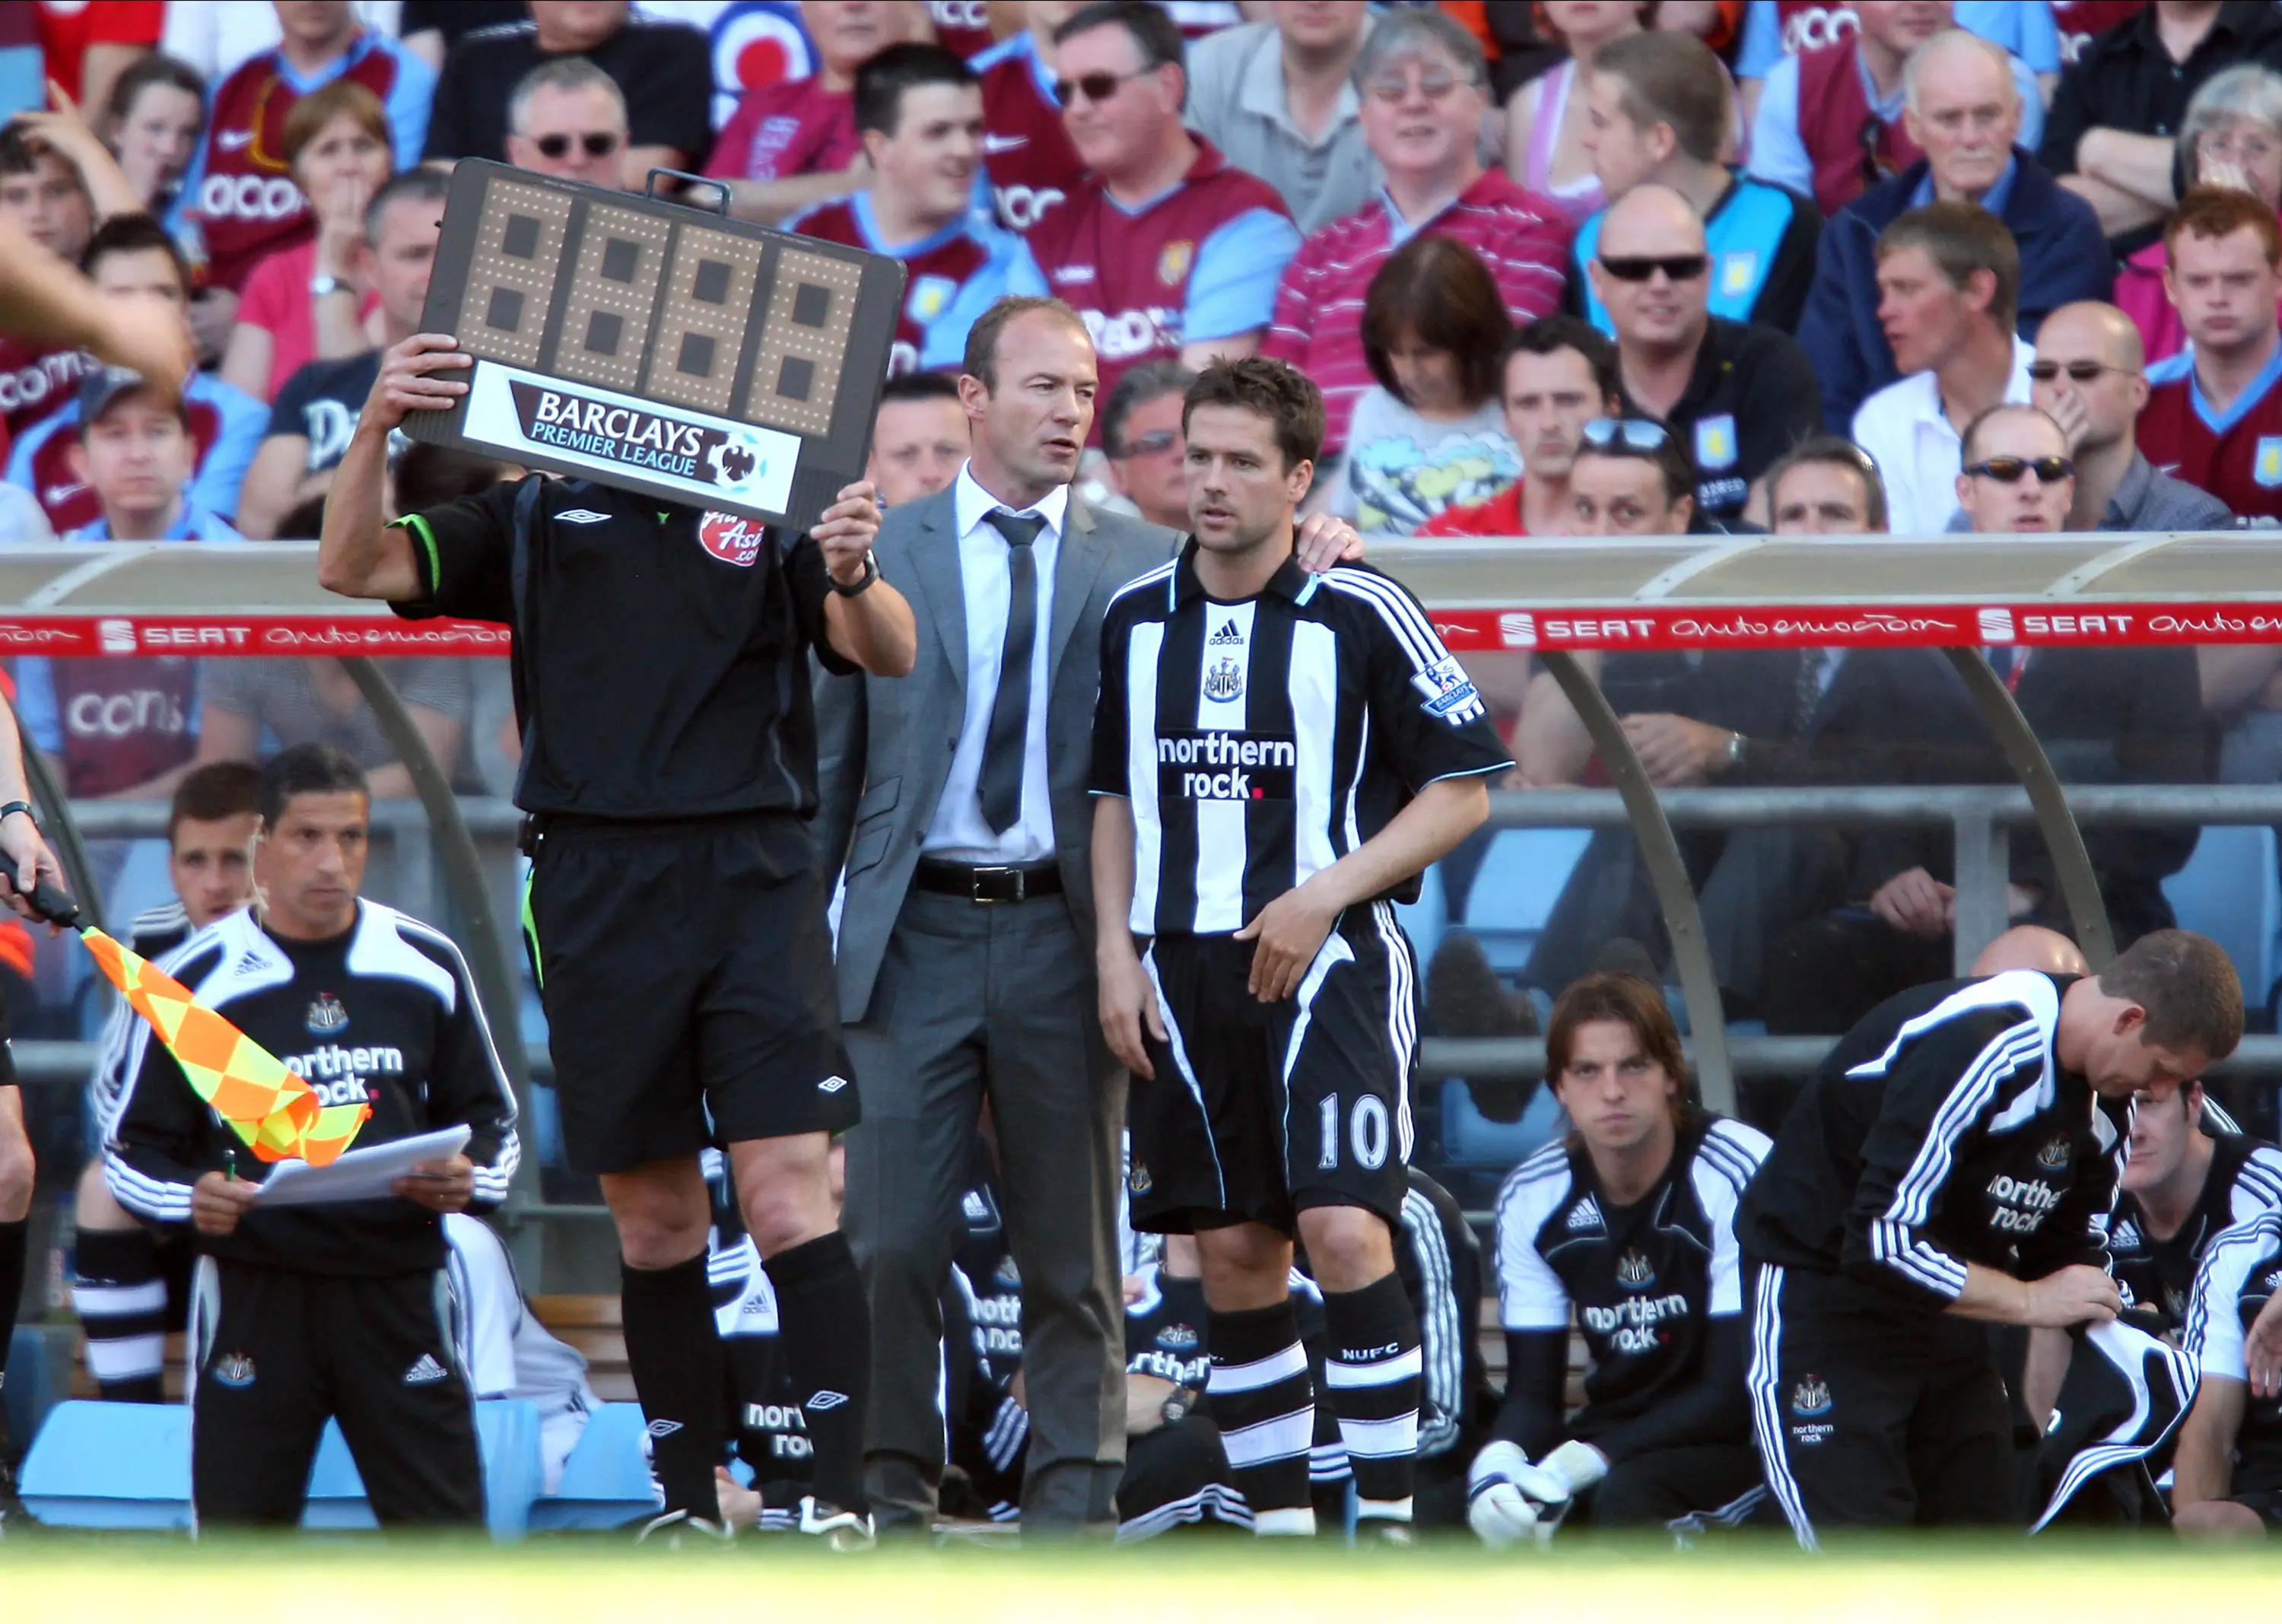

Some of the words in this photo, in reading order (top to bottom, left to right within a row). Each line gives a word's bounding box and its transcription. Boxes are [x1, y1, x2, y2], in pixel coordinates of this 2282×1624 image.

[536, 391, 705, 457] BARCLAYS
[530, 421, 615, 458] PREMIER
[621, 443, 698, 477] LEAGUE
[719, 520, 764, 549] Asi
[1545, 619, 1657, 637] SEAT
[2023, 615, 2134, 633] SEAT
[145, 627, 251, 644] SEAT
[1209, 634, 1244, 645] adidas
[1158, 732, 1295, 766] northern
[284, 1044, 403, 1079] orthern
[1318, 1092, 1390, 1171] 10
[1567, 1216, 1600, 1228] adida
[1990, 1205, 2045, 1232] rock
[1341, 1343, 1399, 1360] NUFC
[405, 1368, 448, 1381] adidas
[1792, 1423, 1834, 1435] northern
